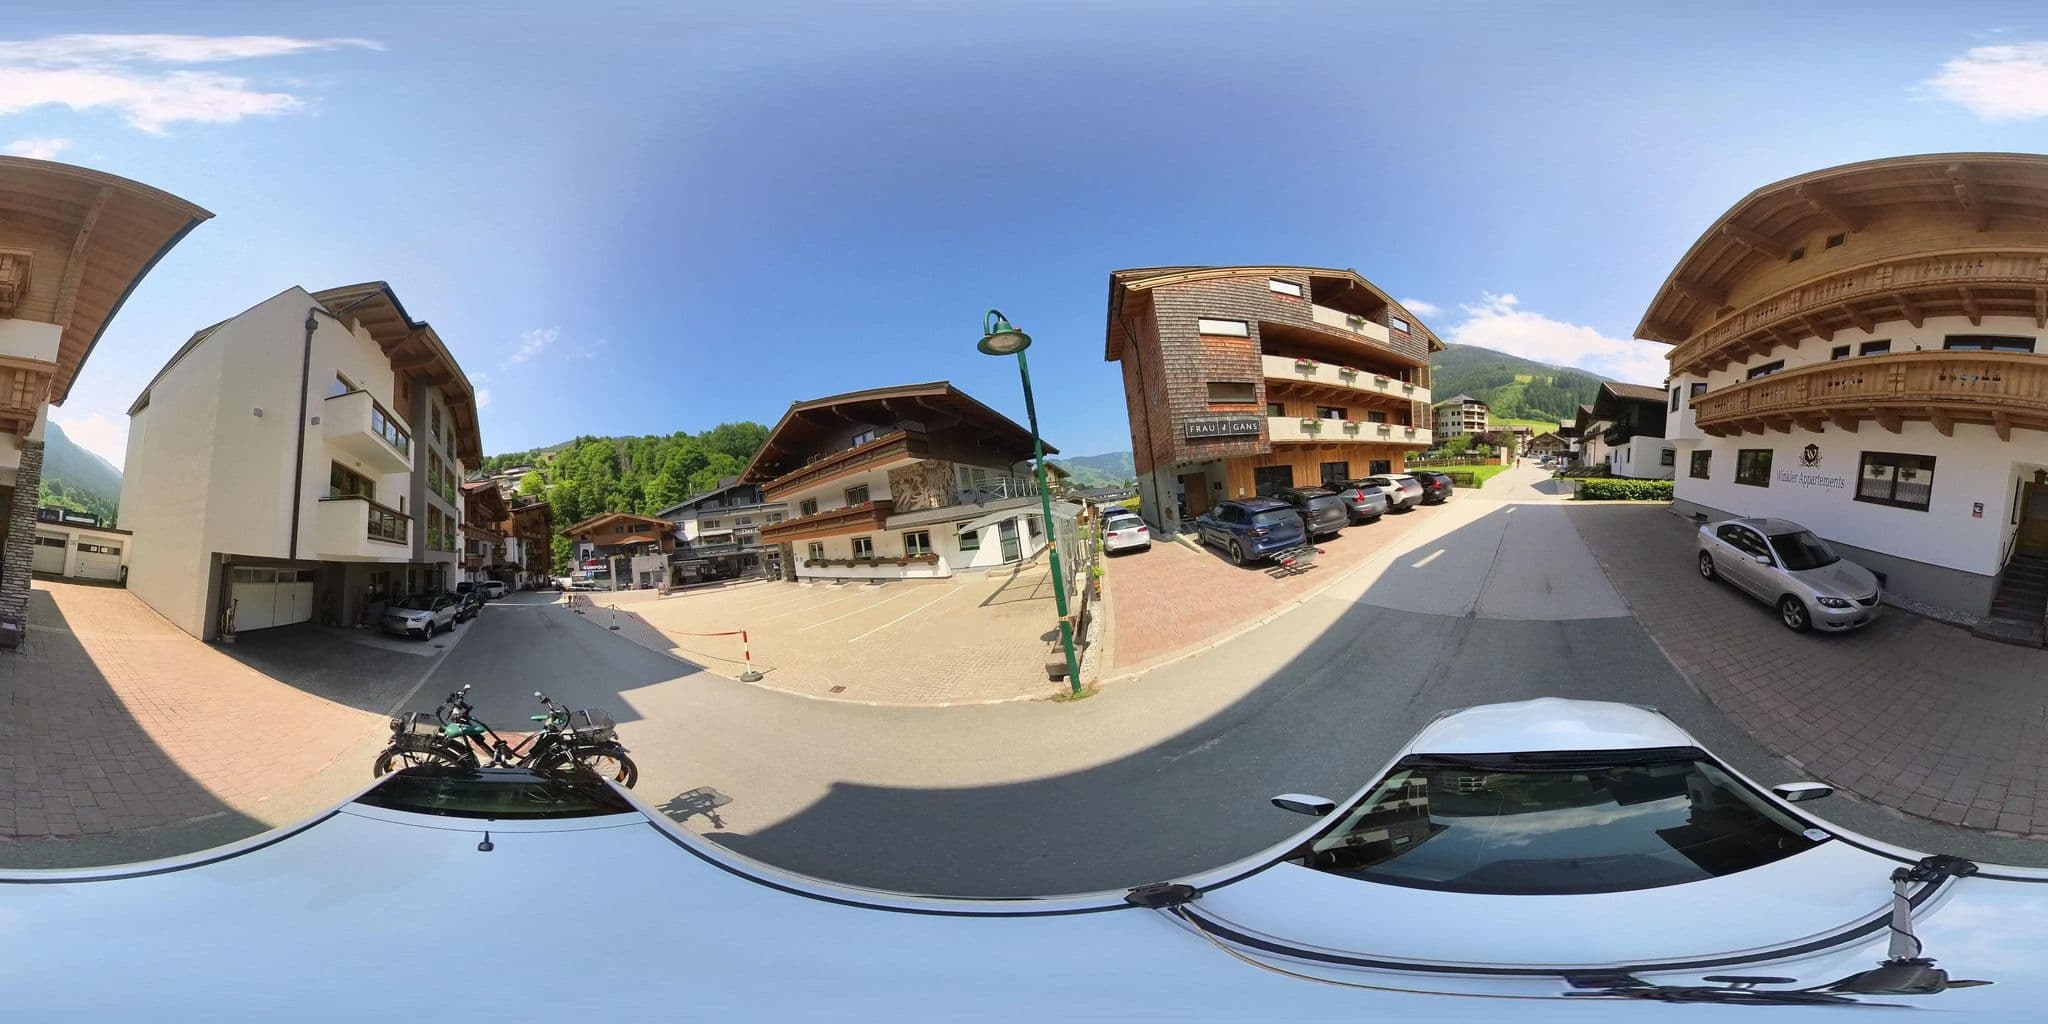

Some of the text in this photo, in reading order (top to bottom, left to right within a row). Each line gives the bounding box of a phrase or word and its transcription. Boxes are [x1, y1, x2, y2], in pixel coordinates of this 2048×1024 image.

[1189, 423, 1258, 433] FRAU GANS
[1806, 448, 1817, 460] W
[1776, 469, 1846, 489] Winkler Appartements
